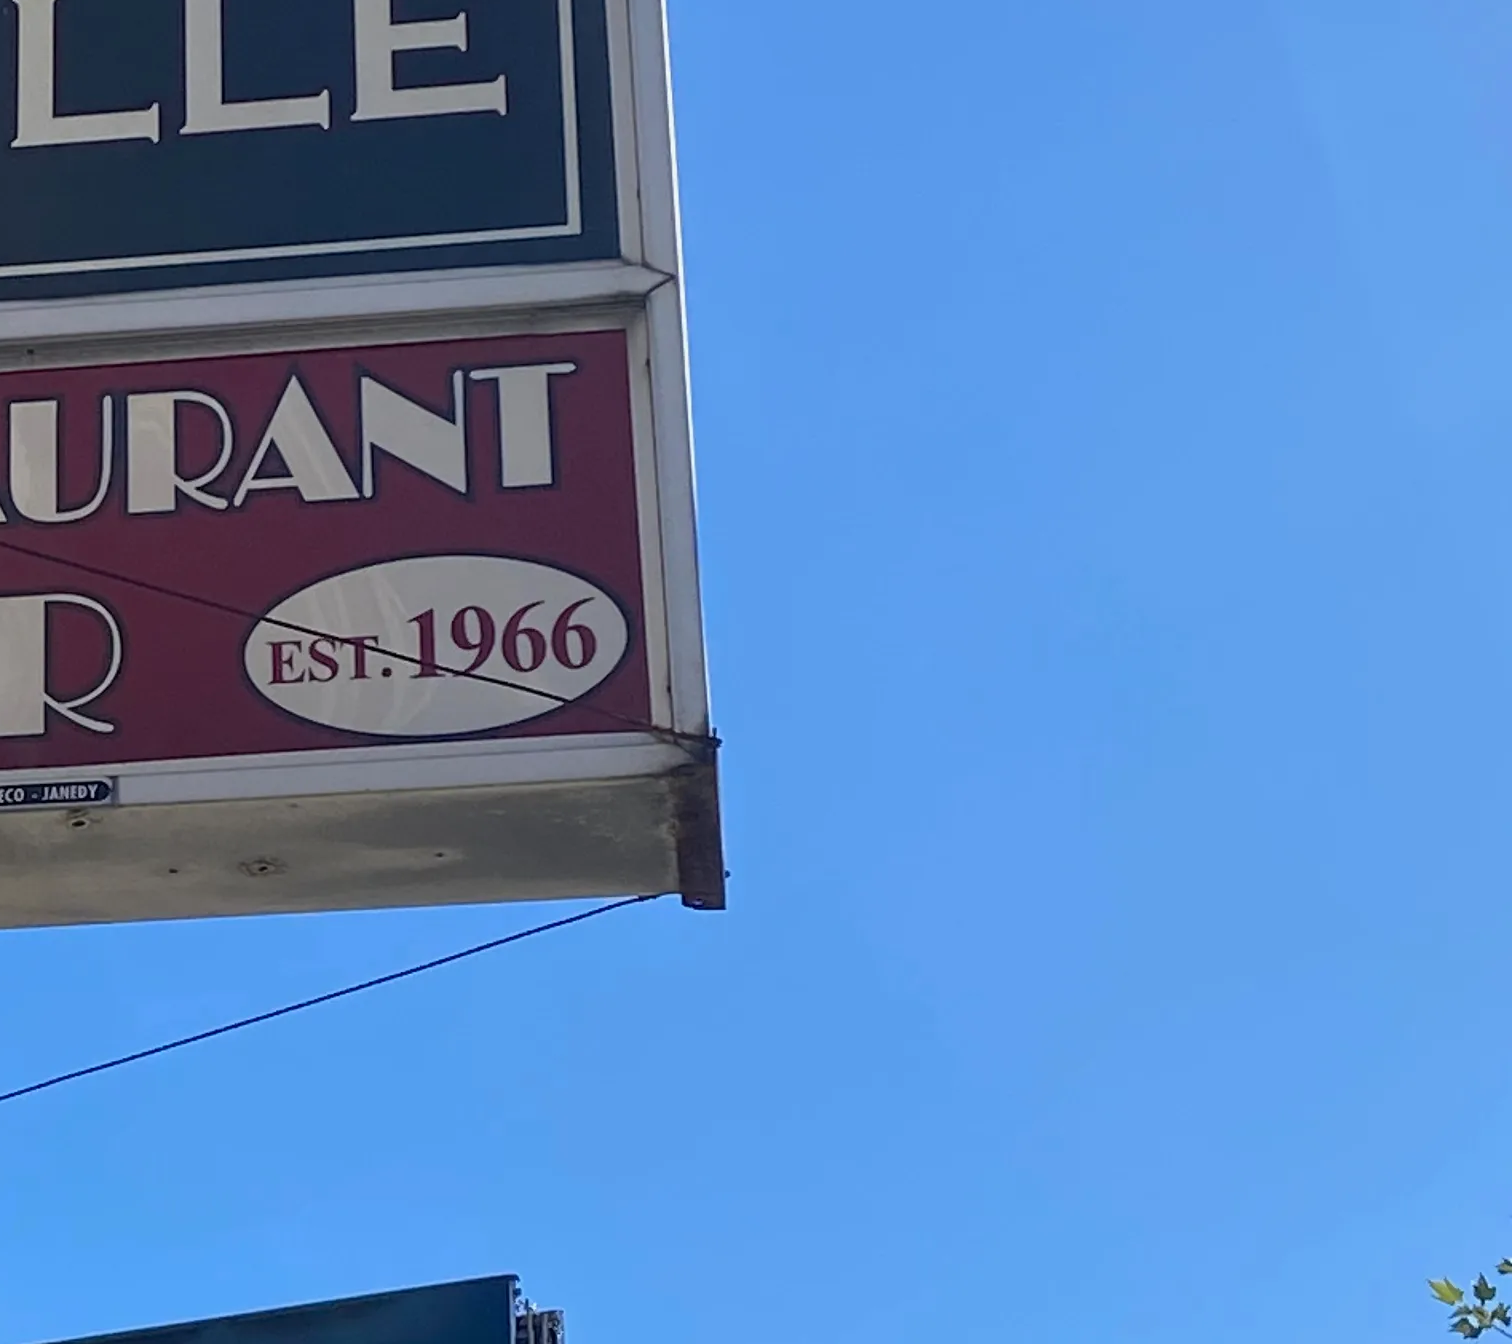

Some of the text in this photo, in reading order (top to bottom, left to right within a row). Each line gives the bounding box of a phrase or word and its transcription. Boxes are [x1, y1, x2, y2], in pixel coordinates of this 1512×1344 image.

[267, 595, 599, 687] EST. 1966
[42, 785, 98, 800] JANEDY
